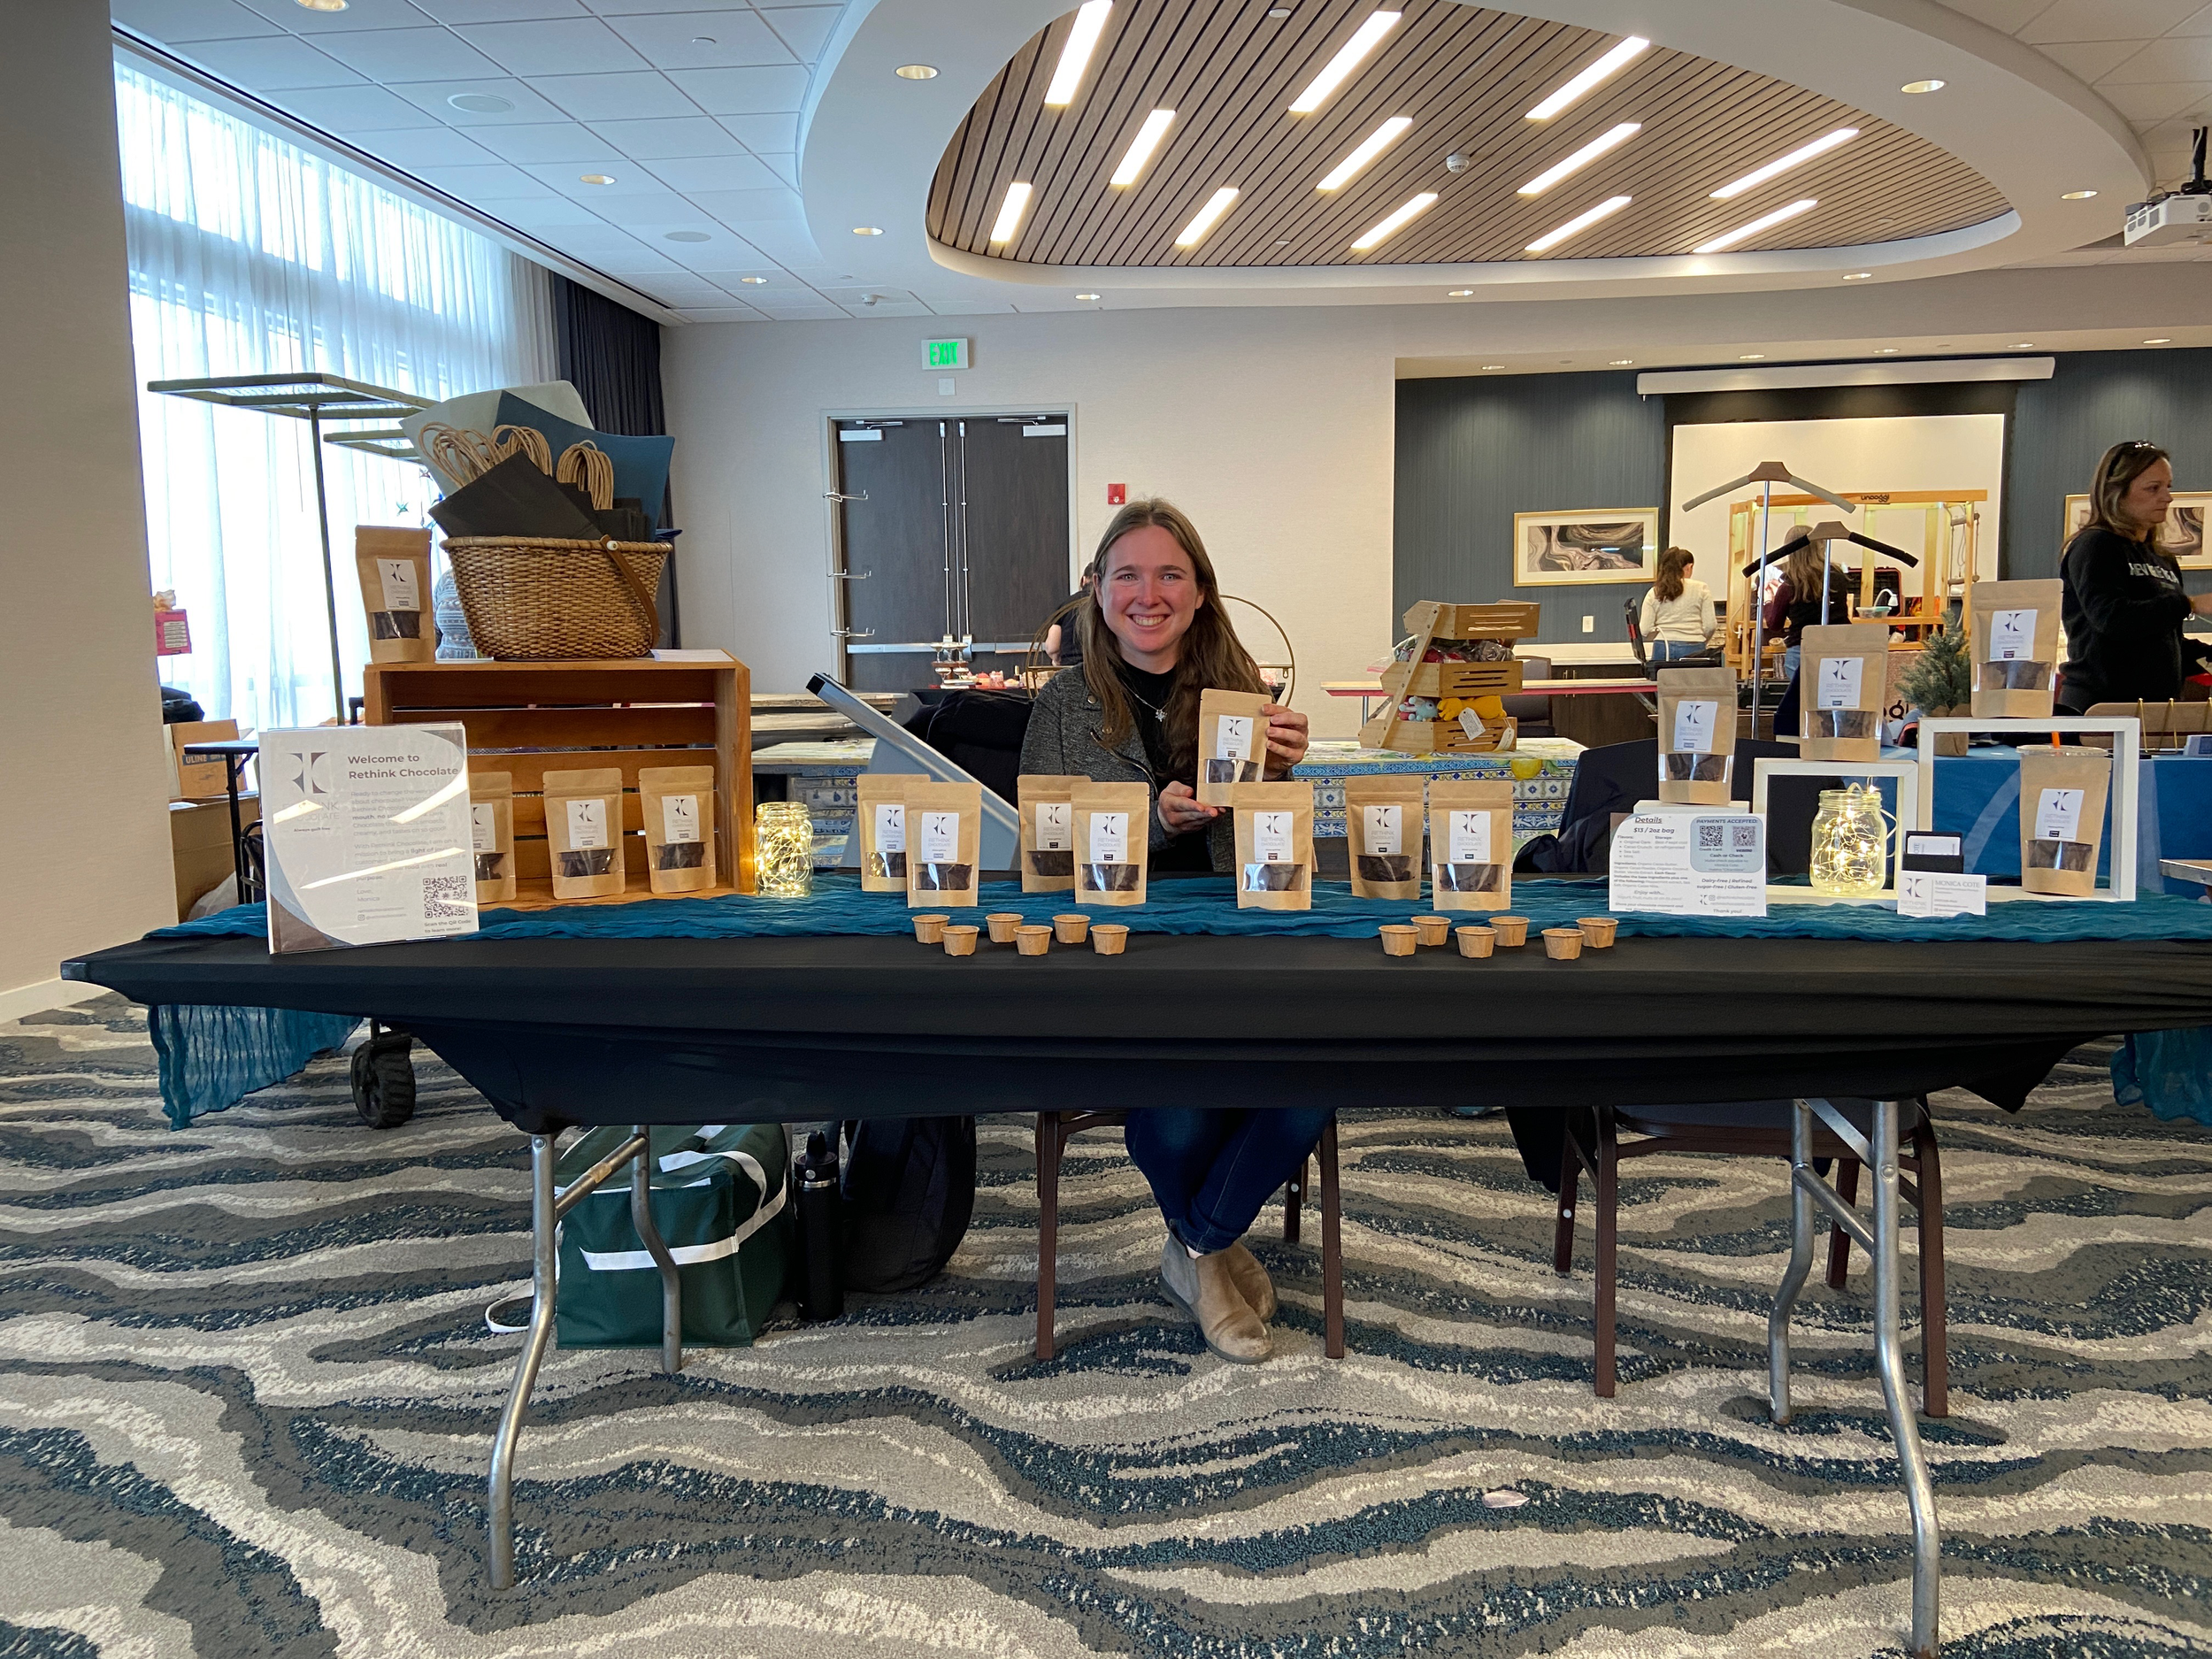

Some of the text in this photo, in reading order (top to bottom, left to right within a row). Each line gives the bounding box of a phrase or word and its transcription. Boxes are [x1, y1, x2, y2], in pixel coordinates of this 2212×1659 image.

[929, 342, 958, 365] EXIT
[186, 755, 207, 764] ULINE
[348, 756, 404, 764] Welcome
[349, 767, 458, 779] Rethink Chocolate
